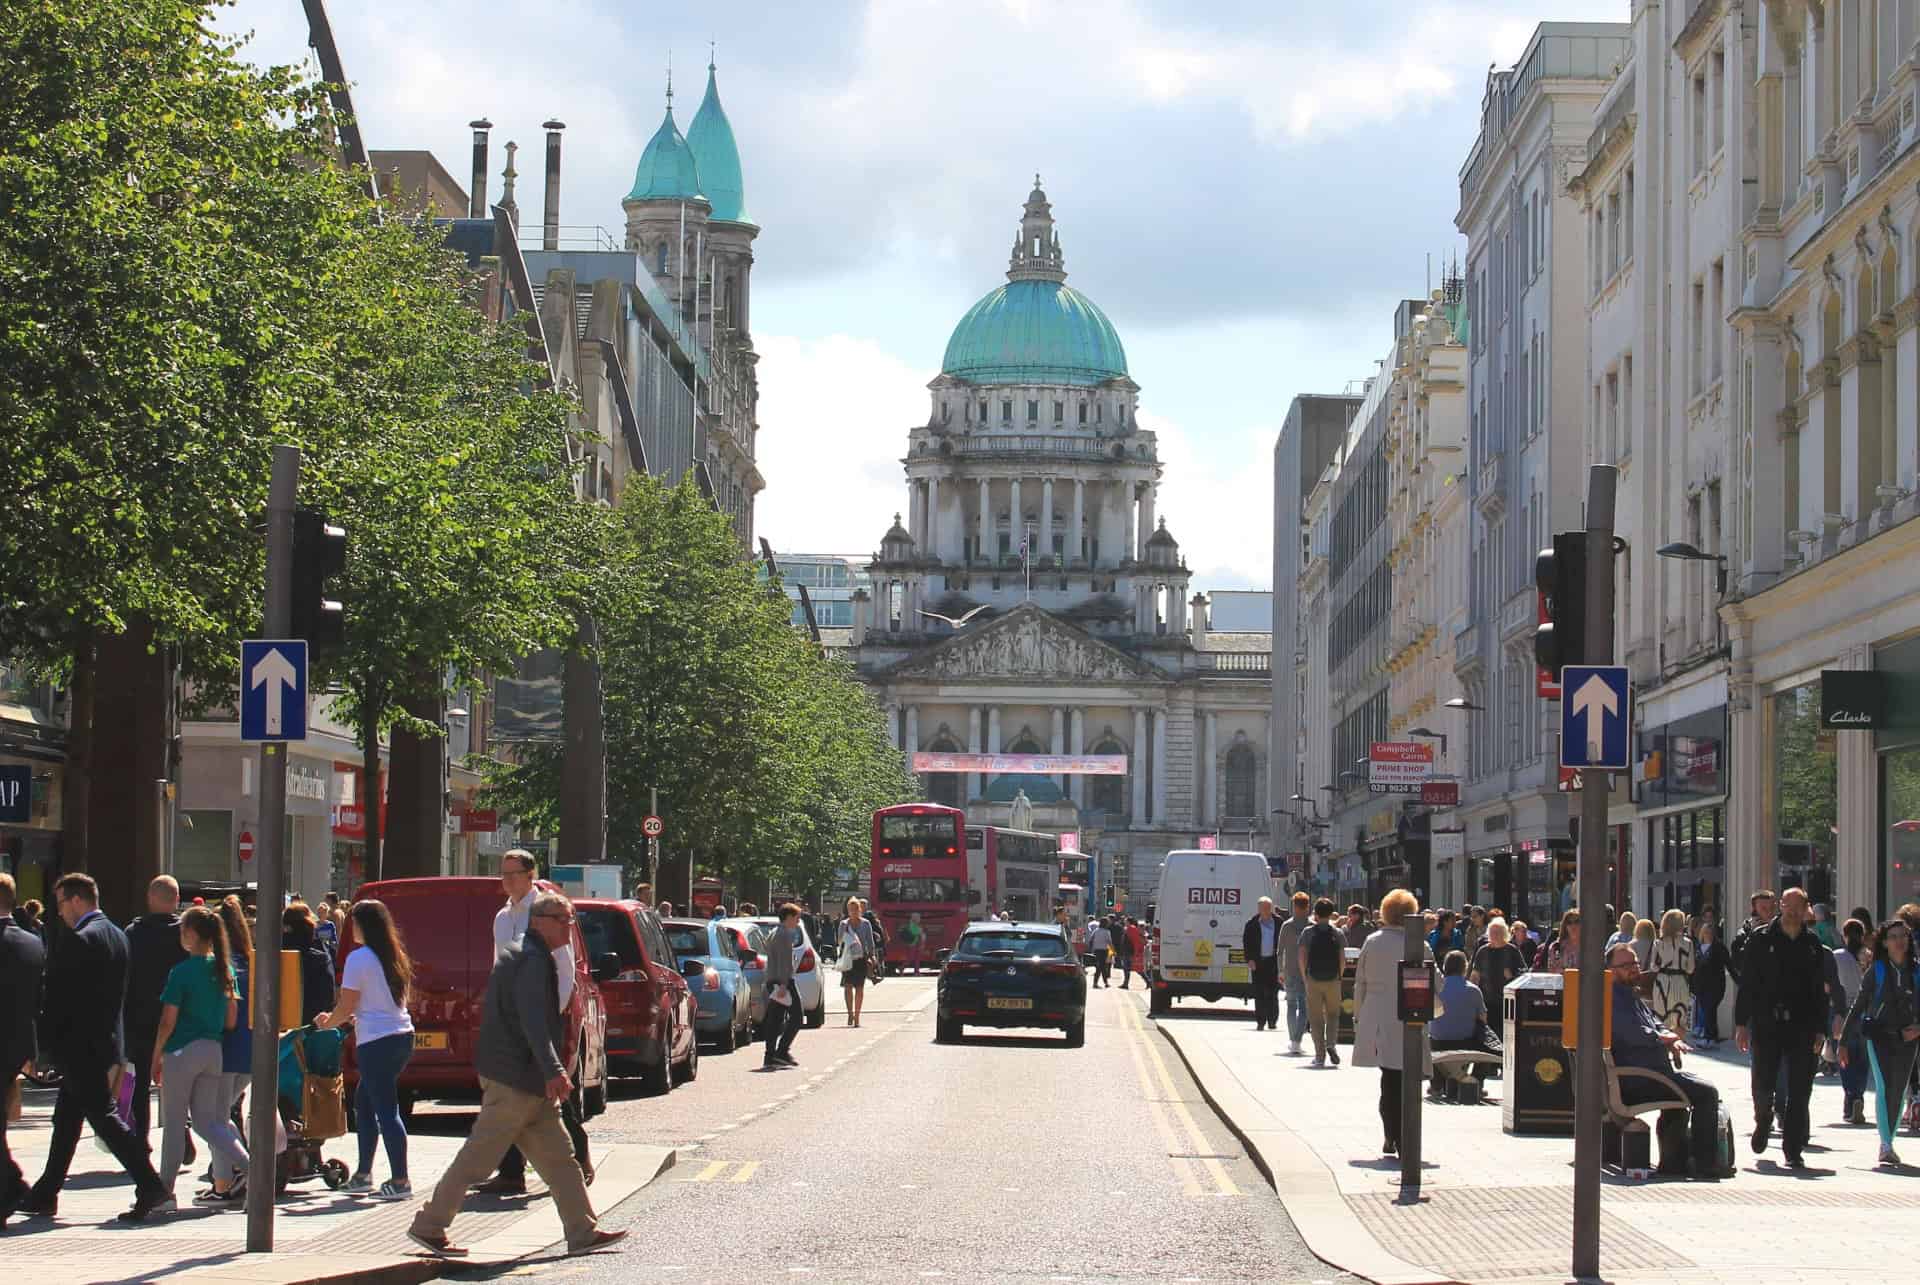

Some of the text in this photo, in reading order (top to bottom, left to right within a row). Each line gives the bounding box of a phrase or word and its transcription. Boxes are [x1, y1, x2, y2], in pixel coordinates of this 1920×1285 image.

[1830, 710, 1871, 722] Clarks
[1376, 745, 1415, 754] Campbell
[646, 821, 660, 831] 20
[1190, 889, 1239, 904] RMS
